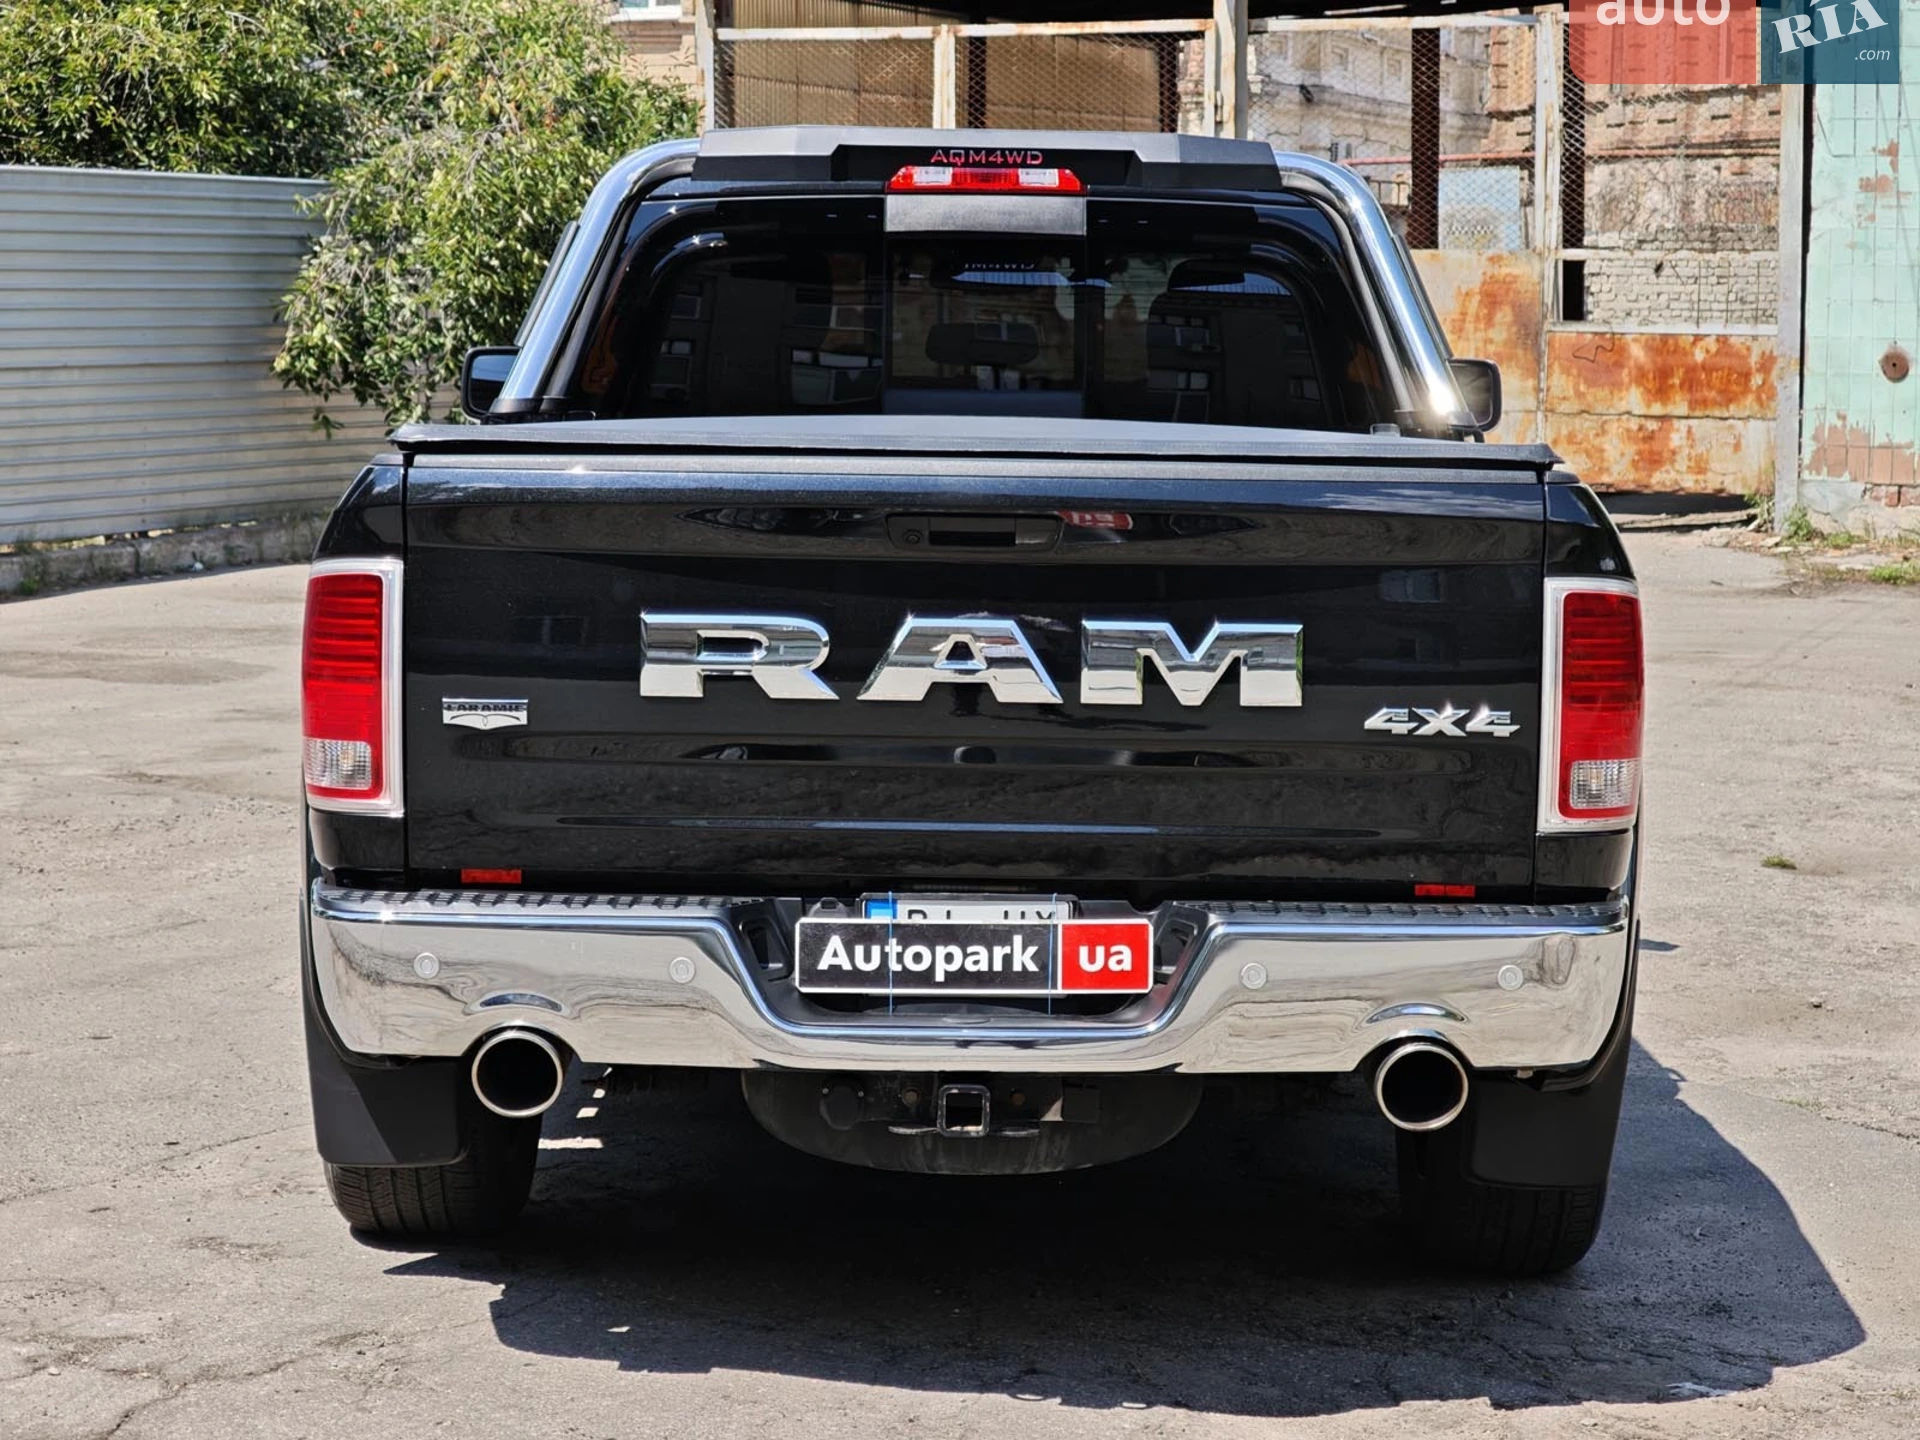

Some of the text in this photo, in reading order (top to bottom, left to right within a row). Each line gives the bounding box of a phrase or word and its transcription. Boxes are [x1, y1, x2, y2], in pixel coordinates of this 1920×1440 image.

[930, 149, 1044, 165] AQM4WD
[640, 612, 1304, 706] RAM
[444, 703, 525, 712] LARAMIE
[817, 934, 1133, 982] Autopark ua
